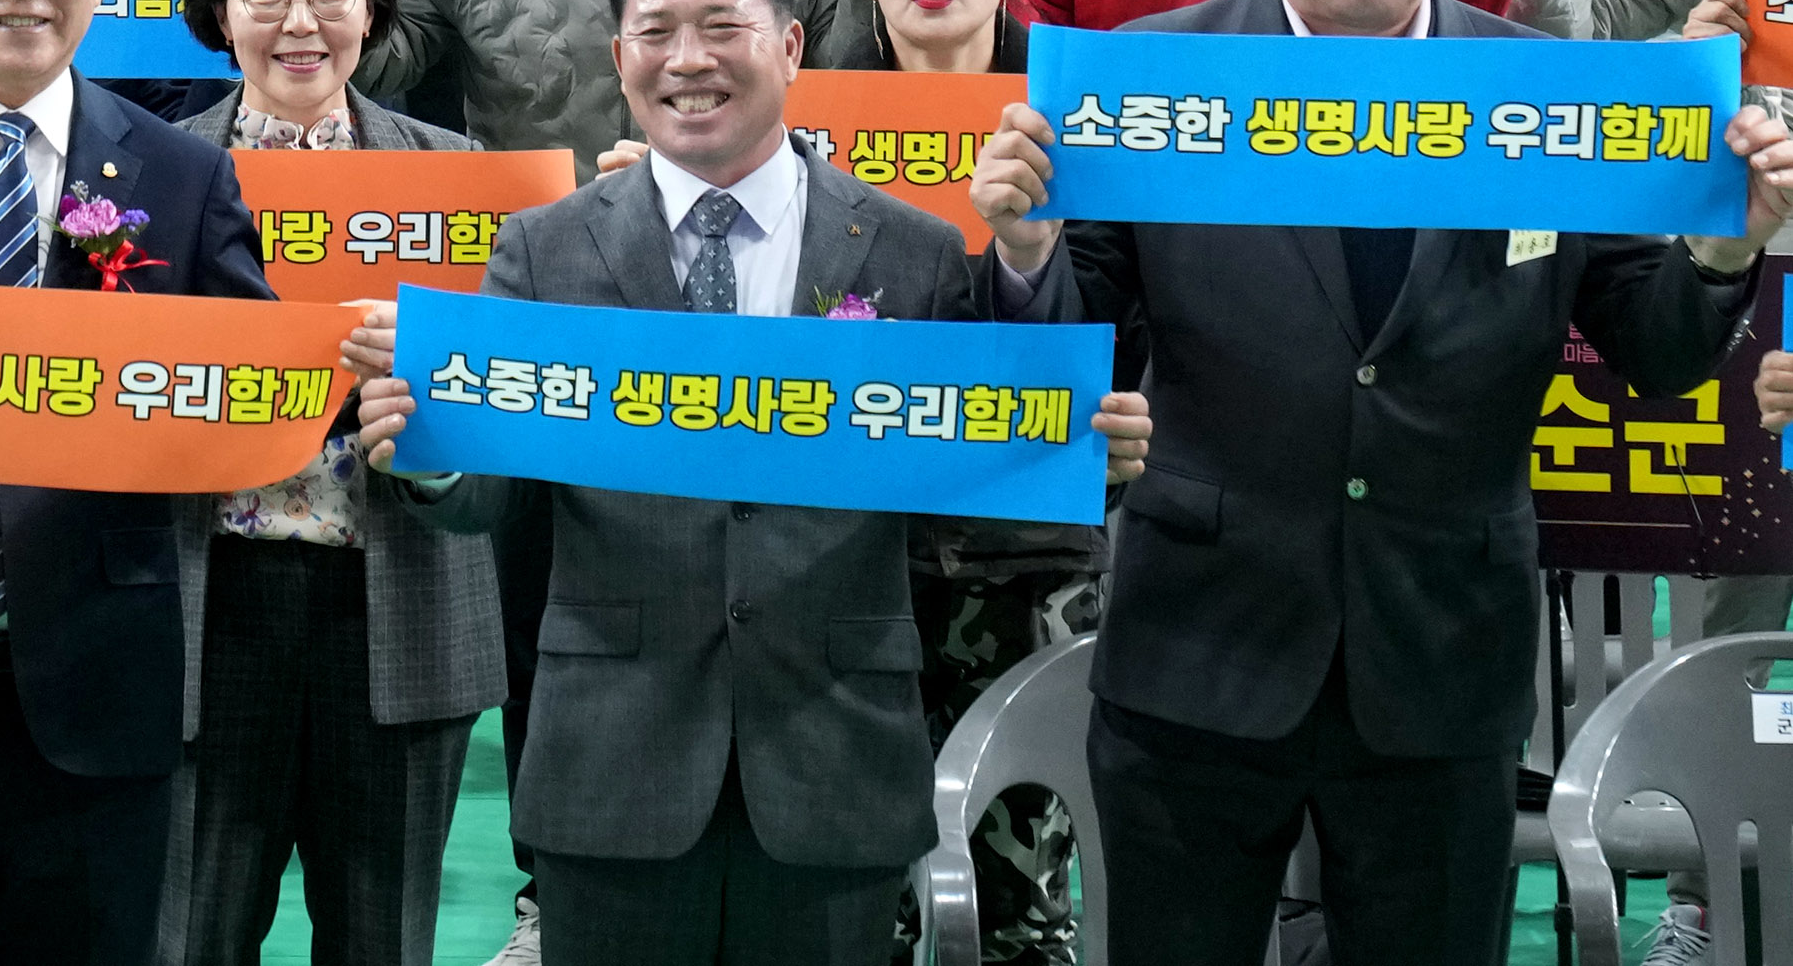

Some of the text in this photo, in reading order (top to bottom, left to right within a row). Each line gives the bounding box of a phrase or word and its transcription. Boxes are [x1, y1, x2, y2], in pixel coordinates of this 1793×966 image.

[1061, 94, 1712, 162] 소중한 생명사랑 우리함께
[345, 211, 494, 264] 우리함
[116, 361, 332, 423] 우리함께
[429, 353, 1072, 444] 소중한 생명사랑 우리함께
